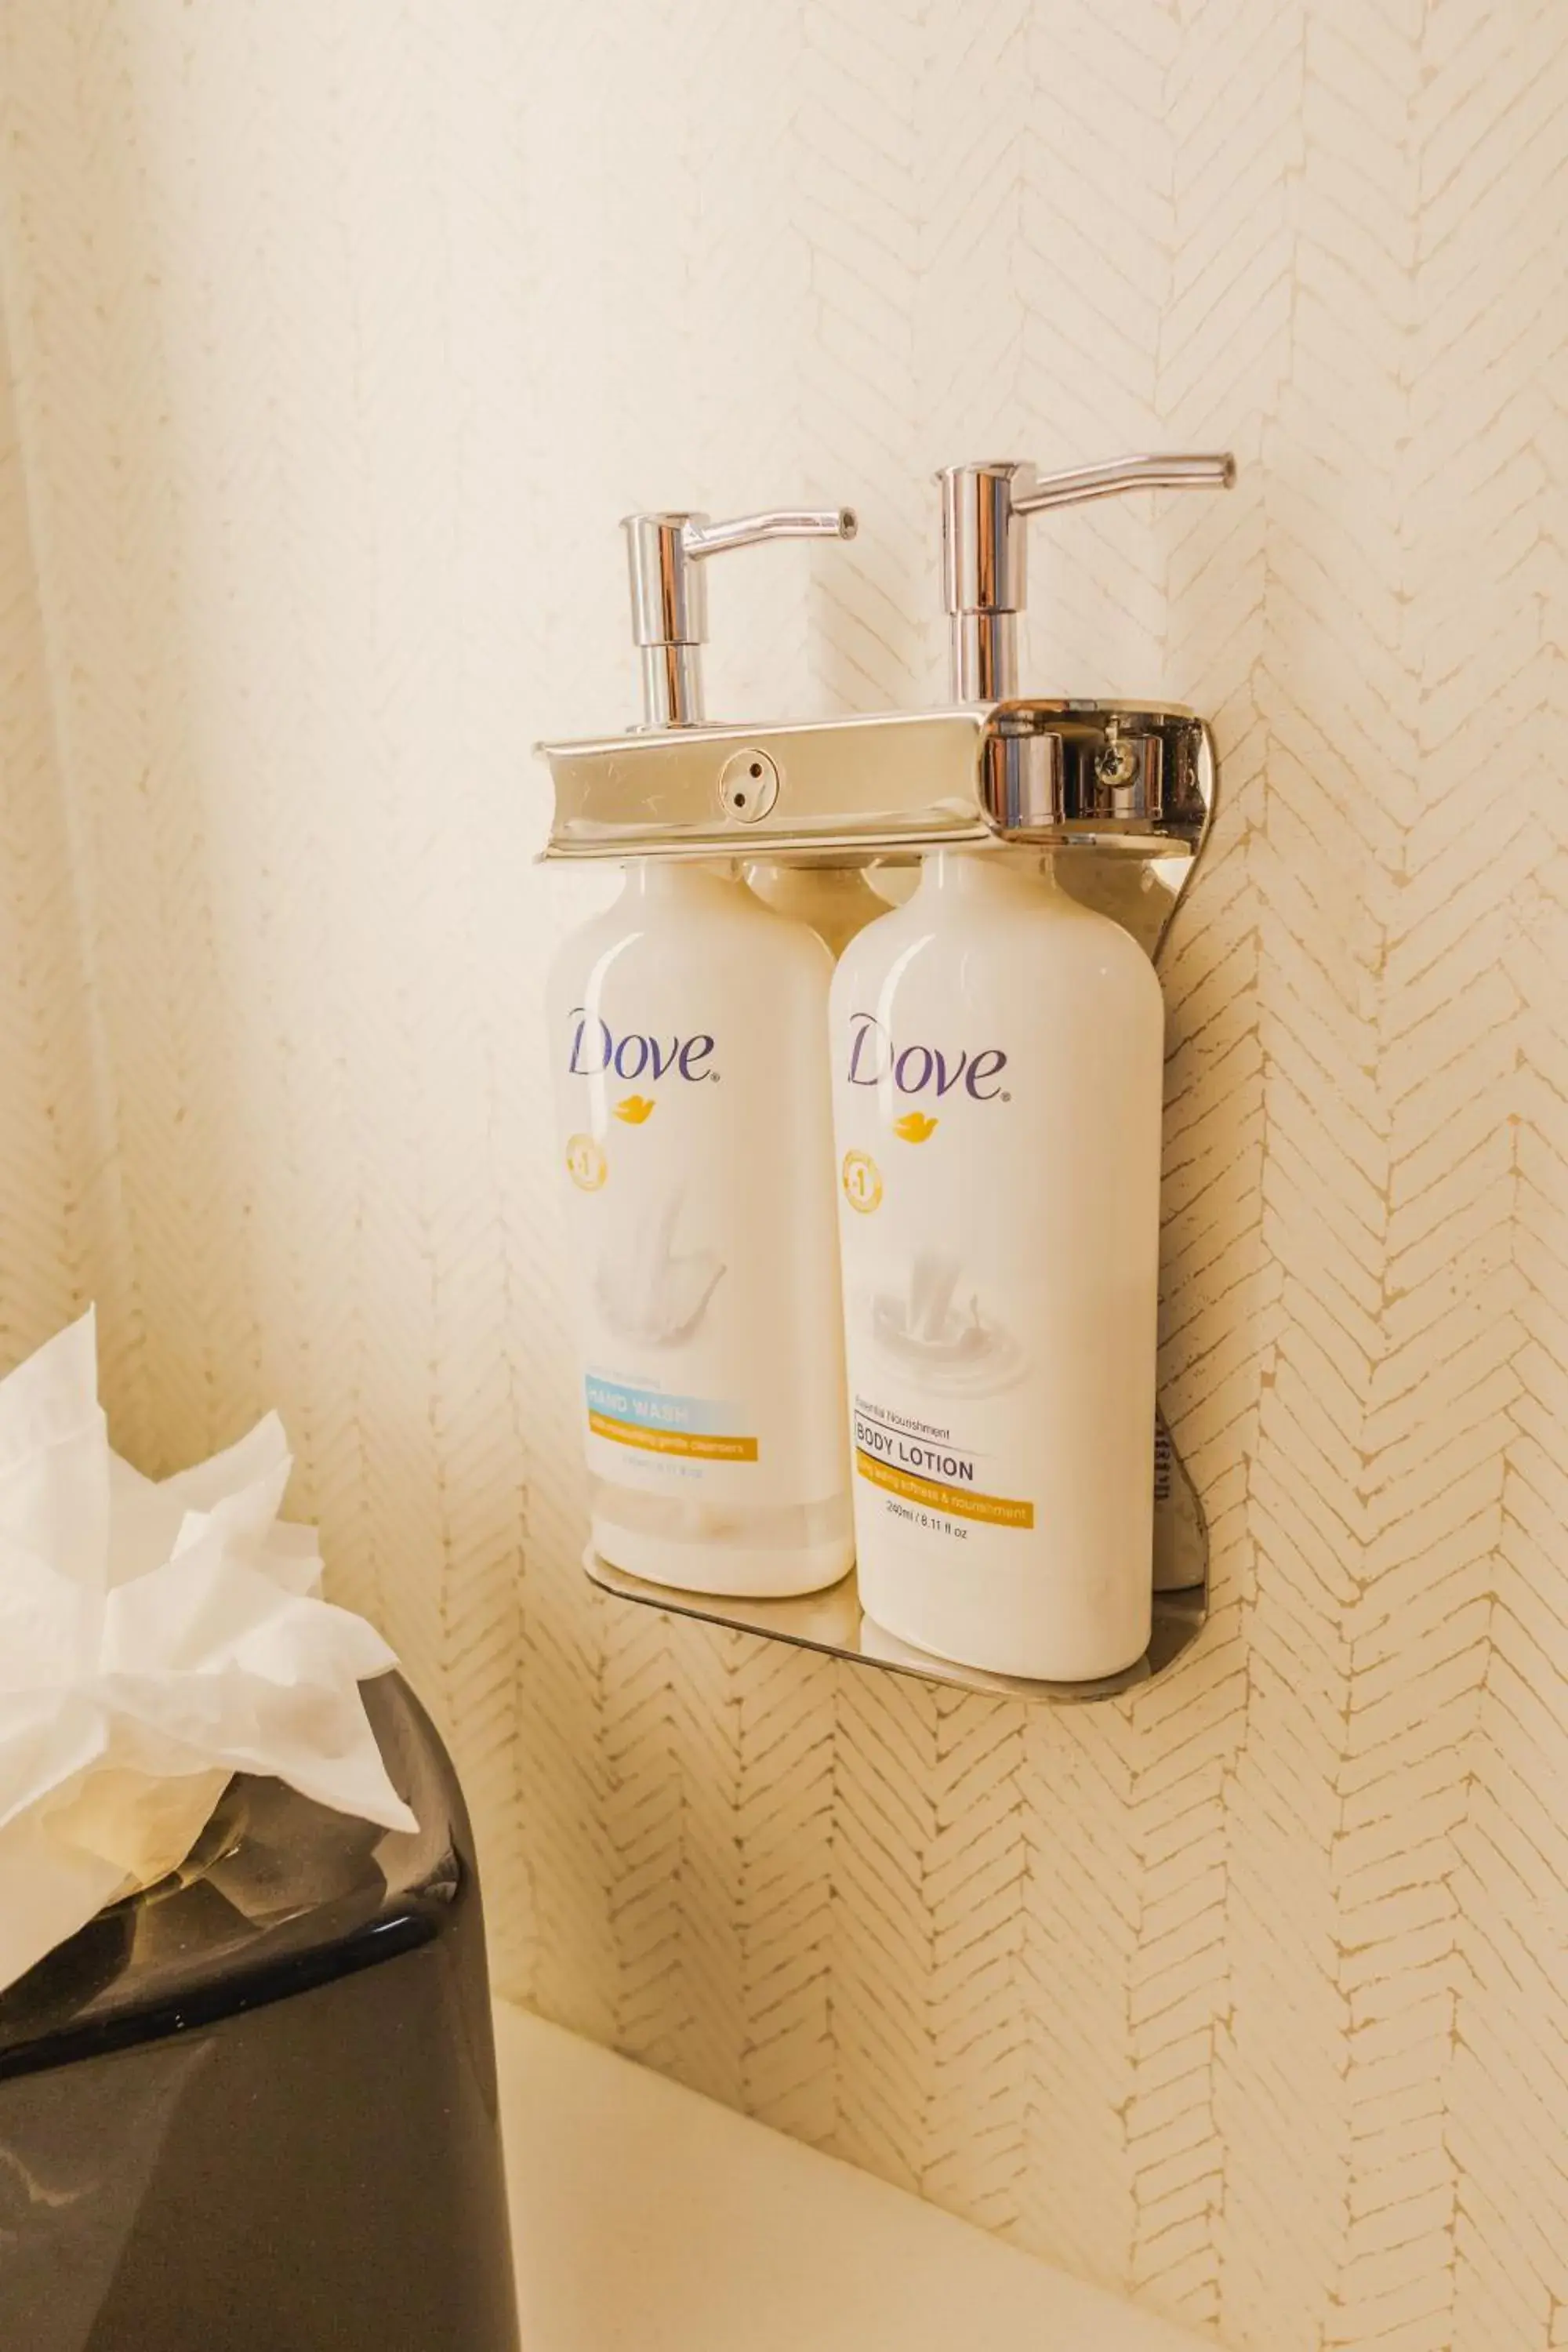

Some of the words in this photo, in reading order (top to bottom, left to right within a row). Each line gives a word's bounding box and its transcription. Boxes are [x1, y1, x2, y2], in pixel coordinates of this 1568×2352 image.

[568, 1007, 715, 1081] Dove
[848, 1013, 1007, 1101] Dove
[632, 1398, 689, 1424] WASH
[887, 1410, 951, 1440] Nourishment
[856, 1421, 893, 1456] BODY
[898, 1441, 974, 1481] LOTION
[885, 1501, 913, 1520] 240ml
[920, 1513, 942, 1530] 8.11
[954, 1527, 968, 1539] oz
